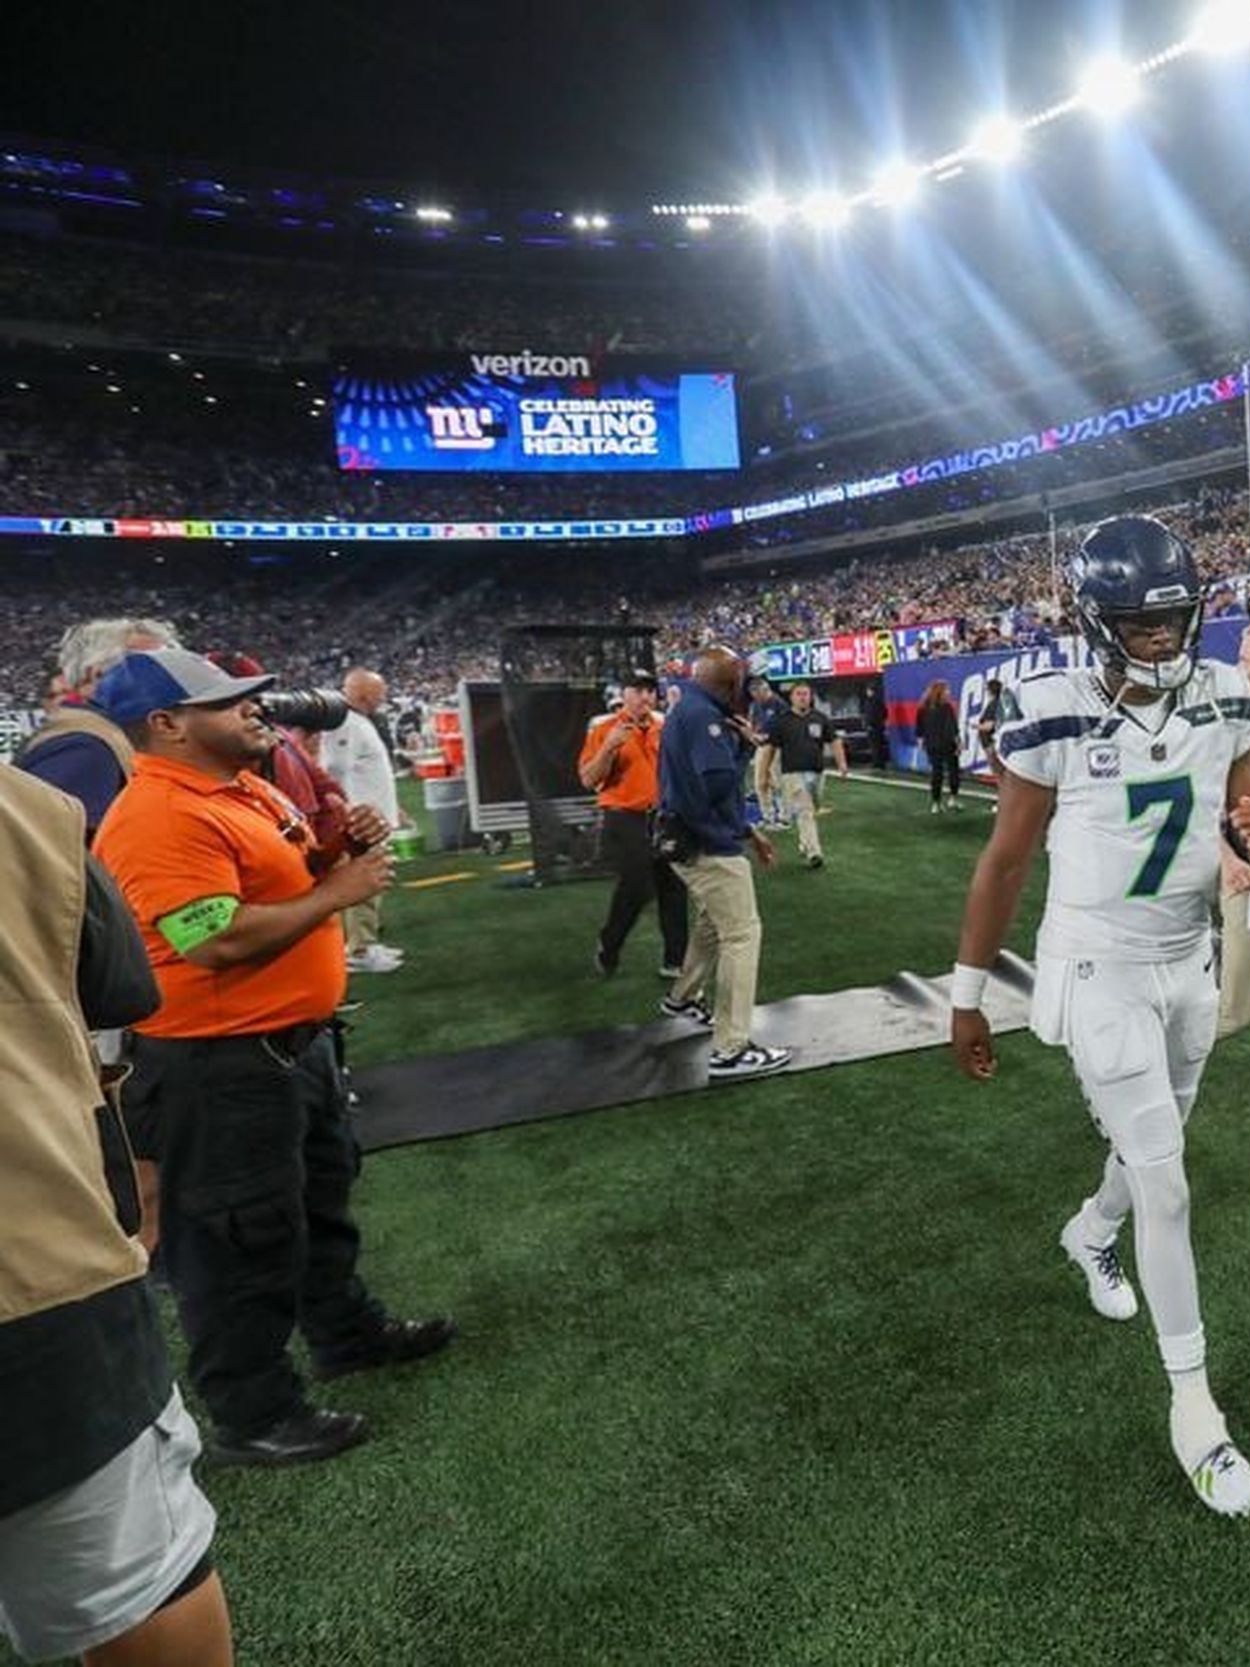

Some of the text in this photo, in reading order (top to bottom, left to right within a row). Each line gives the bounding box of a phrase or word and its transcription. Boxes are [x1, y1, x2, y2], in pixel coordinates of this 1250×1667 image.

[471, 349, 590, 377] verizon
[519, 399, 655, 413] CELEBRATING
[520, 413, 658, 437] LATINO
[522, 436, 660, 455] HERITAGE
[1125, 773, 1195, 900] 7
